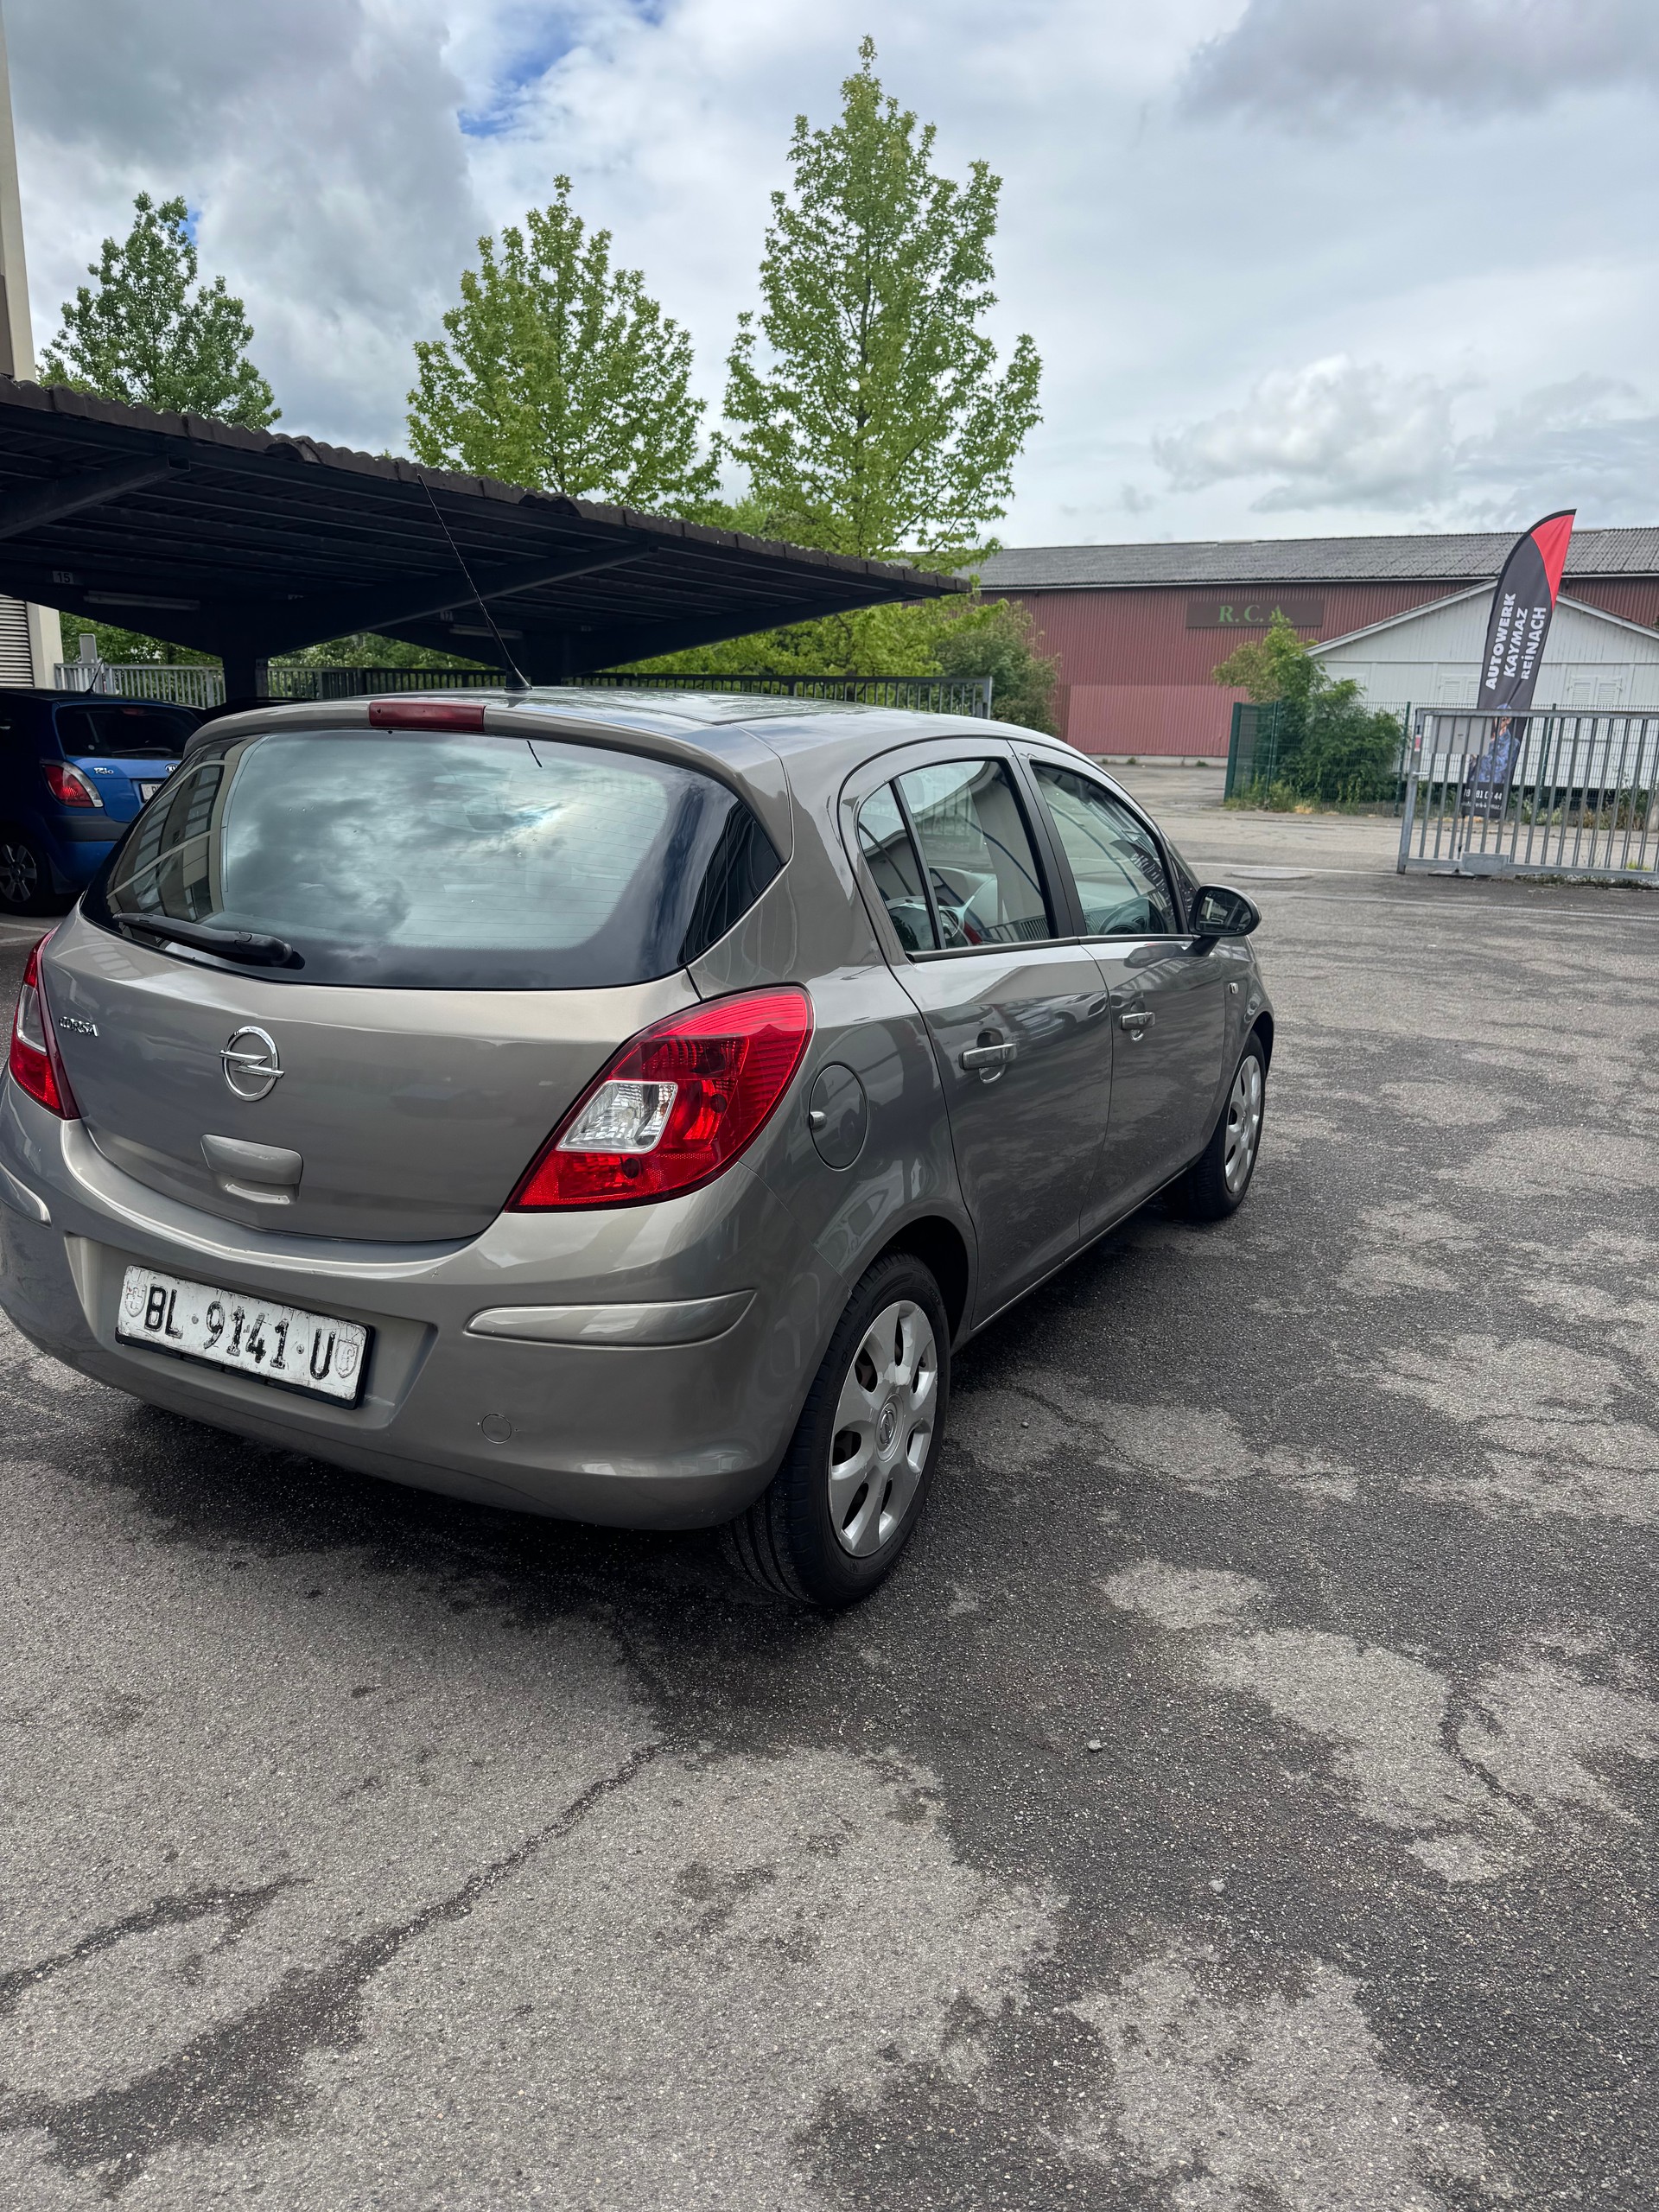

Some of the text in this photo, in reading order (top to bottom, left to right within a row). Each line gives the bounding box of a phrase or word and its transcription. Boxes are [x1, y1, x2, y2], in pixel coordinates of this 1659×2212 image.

[57, 572, 70, 583] 15
[1485, 593, 1516, 690] AUTOWERK
[1503, 607, 1529, 677] KAYMAZ
[59, 1016, 99, 1037] CORSA
[144, 1285, 337, 1380] BL 9141 U
